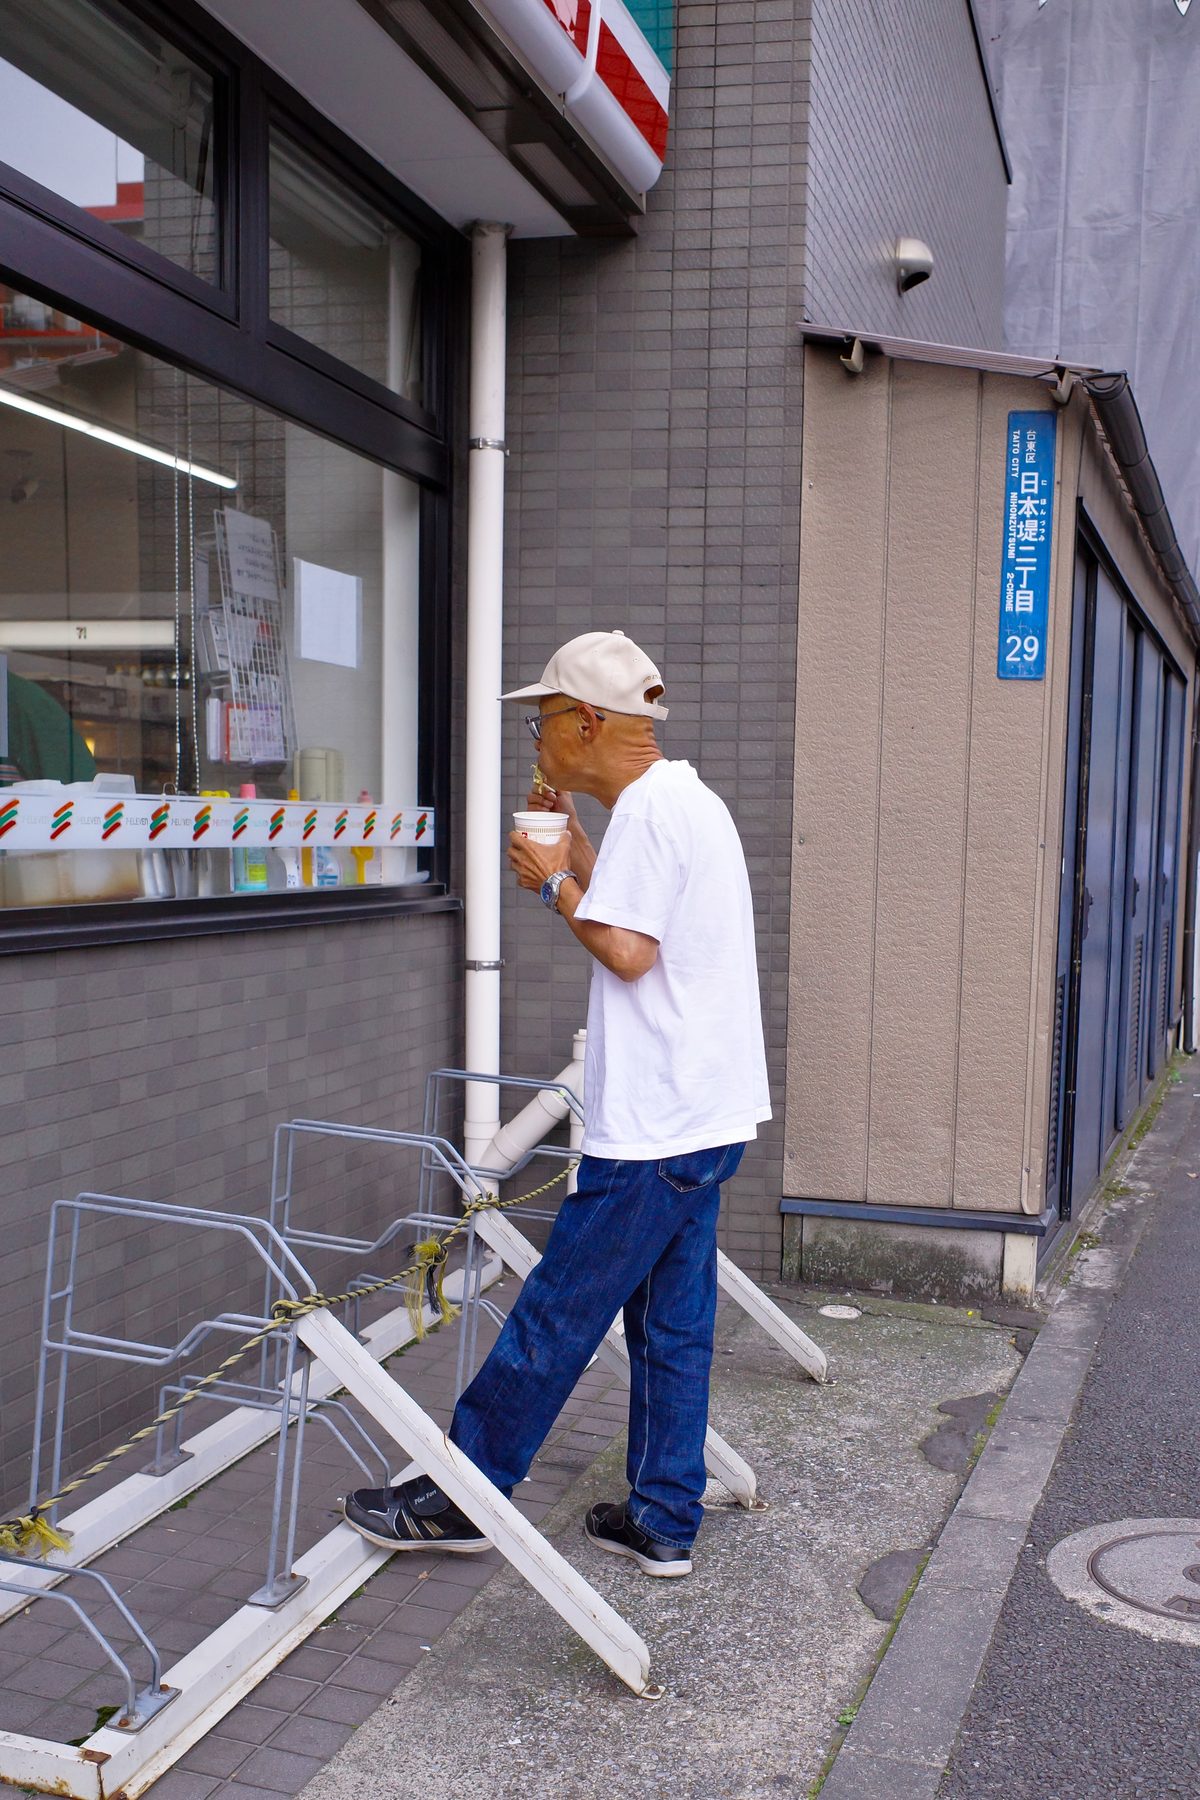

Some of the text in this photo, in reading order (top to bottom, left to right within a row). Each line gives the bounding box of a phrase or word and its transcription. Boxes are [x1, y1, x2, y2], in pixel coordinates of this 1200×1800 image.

[1011, 430, 1020, 477] TAITO CITY
[1025, 430, 1036, 463] 台東区
[1006, 492, 1017, 612] NIHONZUTSUMI 2-CHOME
[1014, 472, 1039, 612] 日本堤二丁目
[1005, 635, 1039, 662] 29
